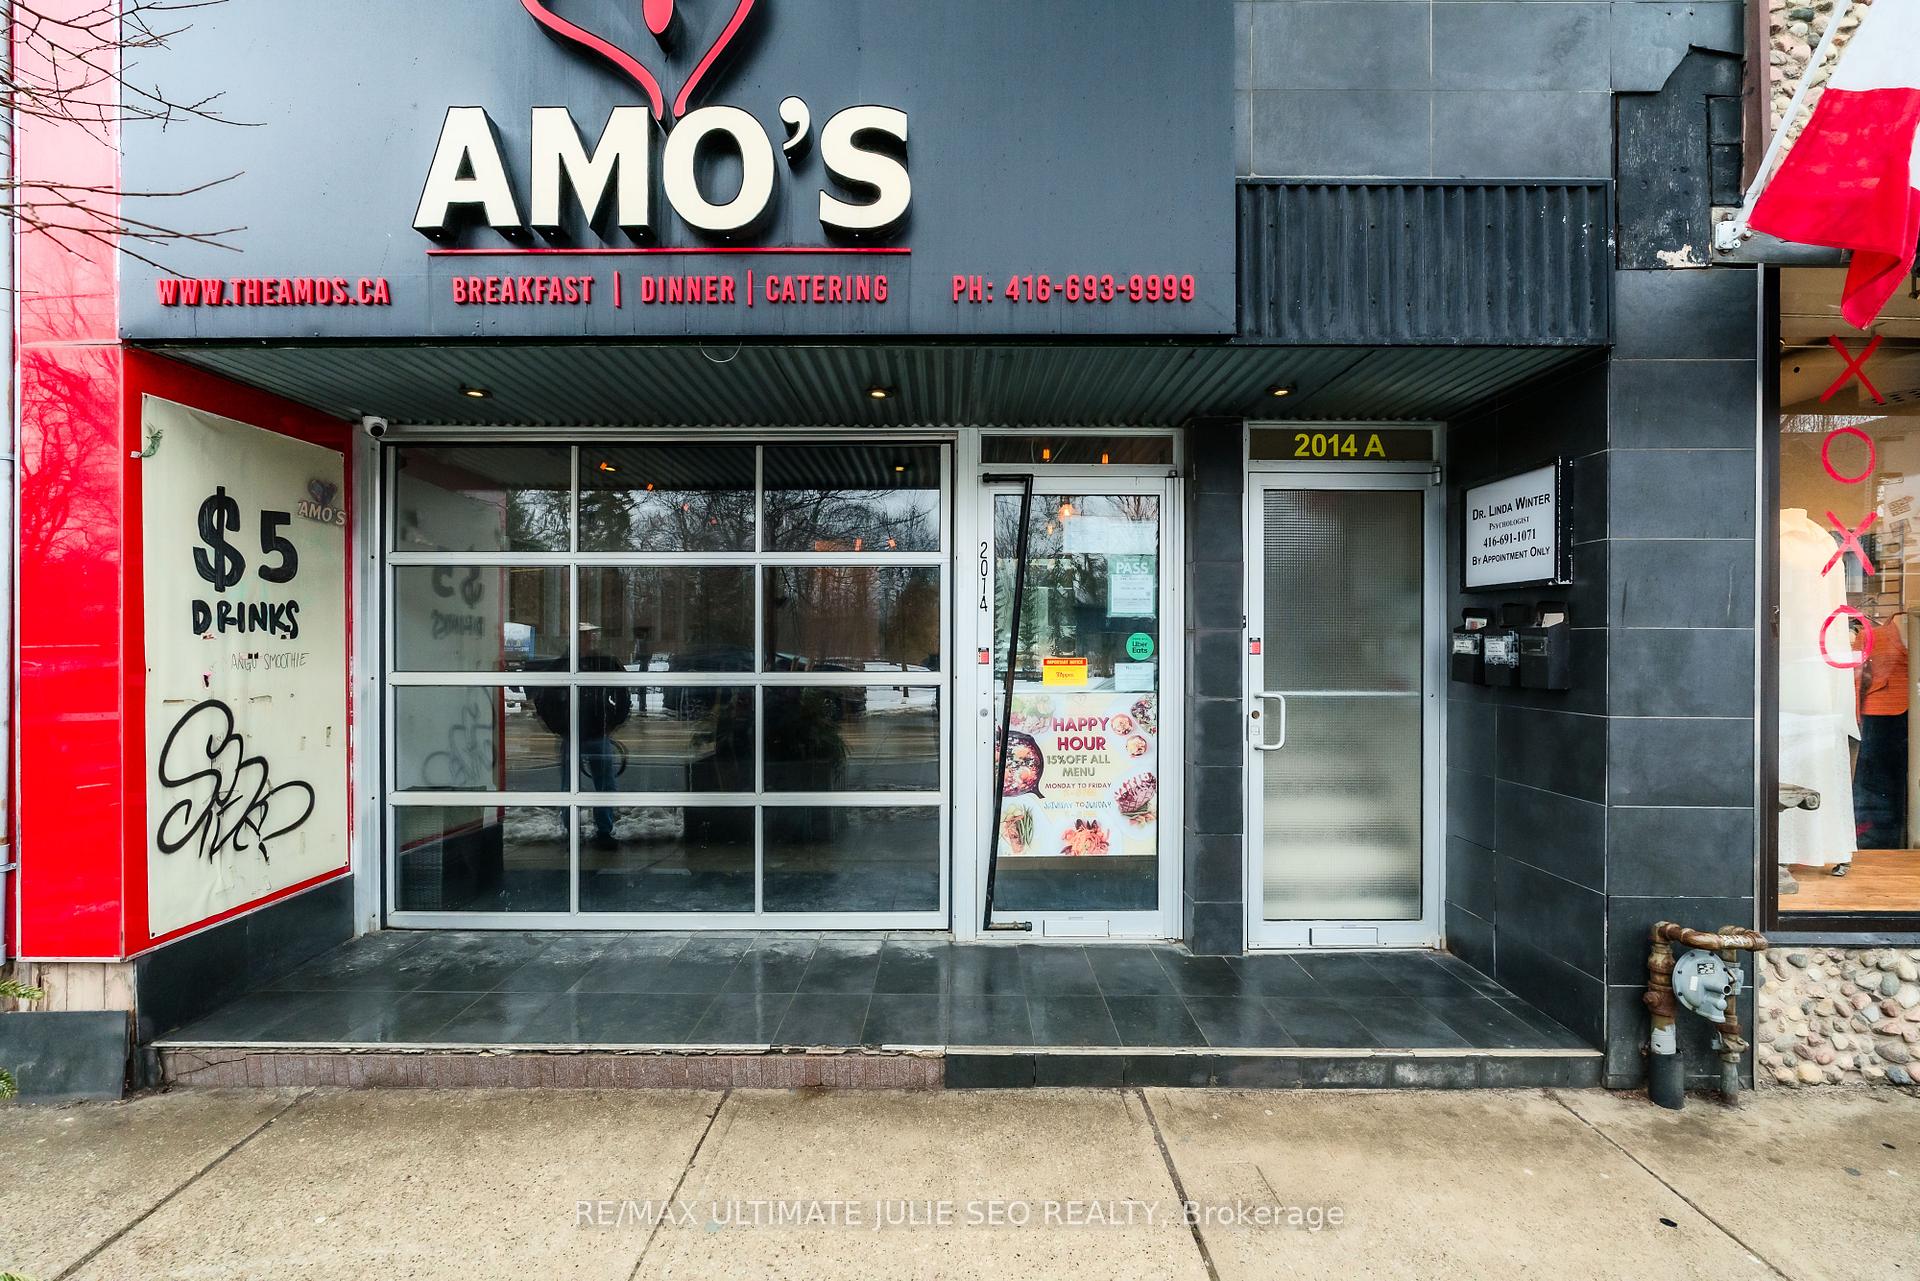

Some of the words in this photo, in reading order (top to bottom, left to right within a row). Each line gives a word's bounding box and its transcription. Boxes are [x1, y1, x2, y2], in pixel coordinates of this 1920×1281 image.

[413, 96, 914, 240] AMO'S
[156, 276, 391, 306] WWW.THEAMOS.CA
[452, 275, 595, 305] BREAKFAST
[641, 274, 737, 303] DINNER
[765, 273, 890, 303] CATERING
[952, 273, 996, 303] PH:
[1005, 272, 1197, 303] 416-693-9999
[1294, 433, 1358, 457] 2014
[1363, 433, 1386, 457] A
[298, 501, 346, 526] AMO'S
[1483, 528, 1536, 548] 416-691-1071
[980, 541, 989, 612] 2014
[1116, 561, 1149, 574] PASS
[192, 600, 299, 639] DRINKS
[1132, 640, 1148, 648] Uber
[1052, 717, 1110, 732] HAPPY
[1057, 736, 1106, 751] HOUR
[1090, 754, 1111, 764] ALL
[1062, 767, 1096, 777] MENU
